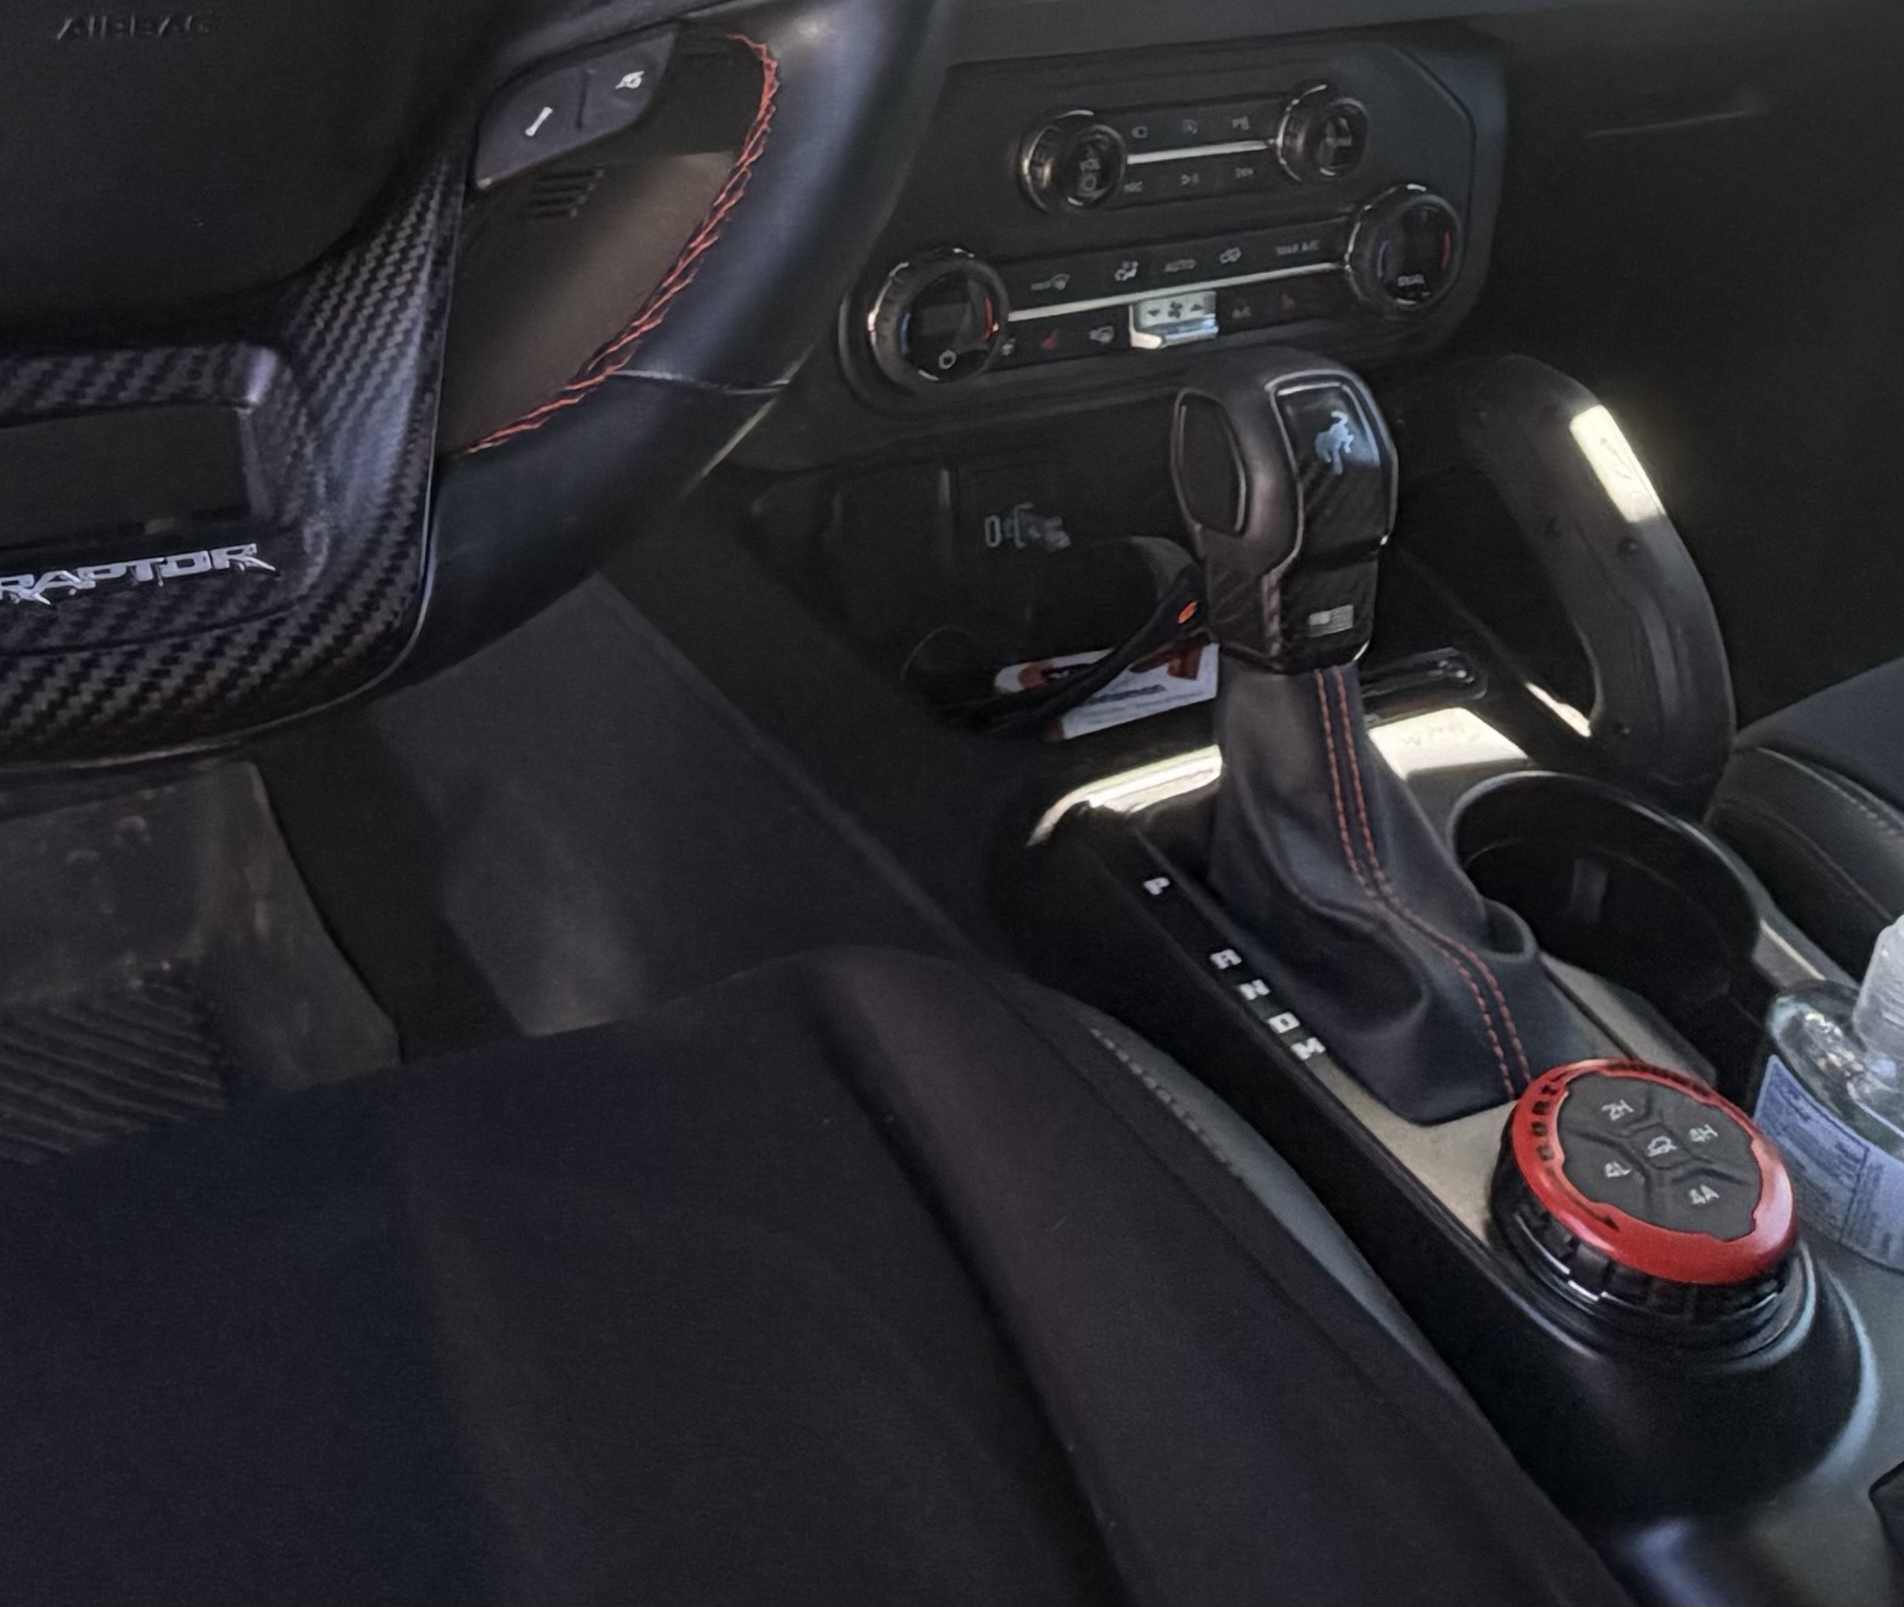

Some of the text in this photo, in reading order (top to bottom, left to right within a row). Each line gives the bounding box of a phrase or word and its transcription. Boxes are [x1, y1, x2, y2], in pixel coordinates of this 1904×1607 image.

[1209, 948, 1243, 969] R
[1238, 978, 1271, 1000] N
[1267, 1011, 1301, 1034] D
[1291, 1036, 1326, 1060] M
[1601, 1098, 1634, 1121] 2H
[1688, 1123, 1719, 1144] 4H
[1603, 1160, 1632, 1179] 4L
[1688, 1183, 1720, 1206] 4A
